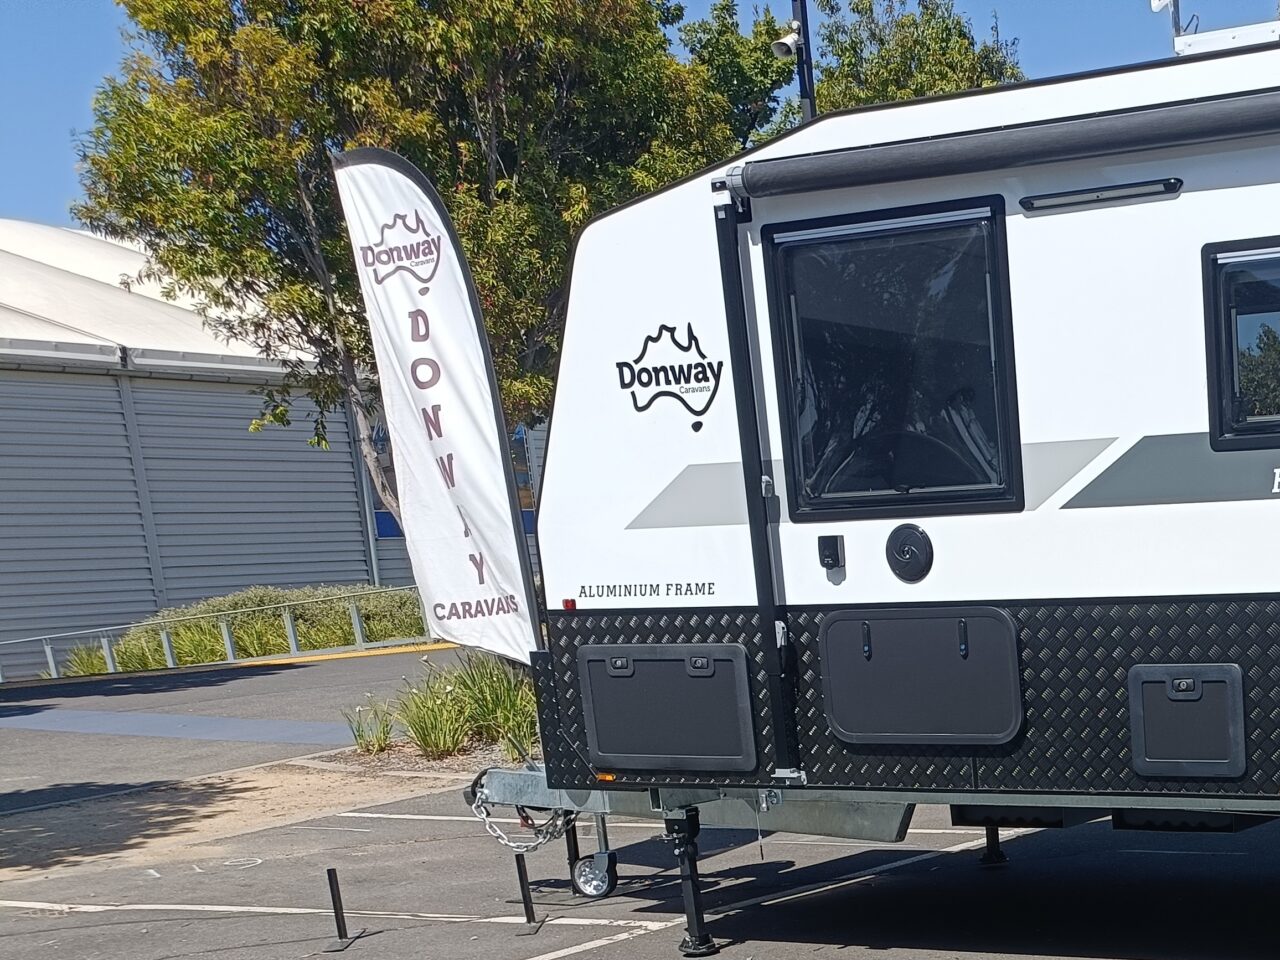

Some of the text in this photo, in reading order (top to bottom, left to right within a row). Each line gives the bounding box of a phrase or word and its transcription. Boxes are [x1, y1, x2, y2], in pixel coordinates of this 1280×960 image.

[360, 235, 441, 267] Donway
[409, 257, 435, 267] Caravans
[615, 360, 724, 389] Donway
[679, 385, 711, 394] Caravans
[408, 308, 485, 586] DONWY
[578, 582, 716, 598] ALUMINIUM FRAME
